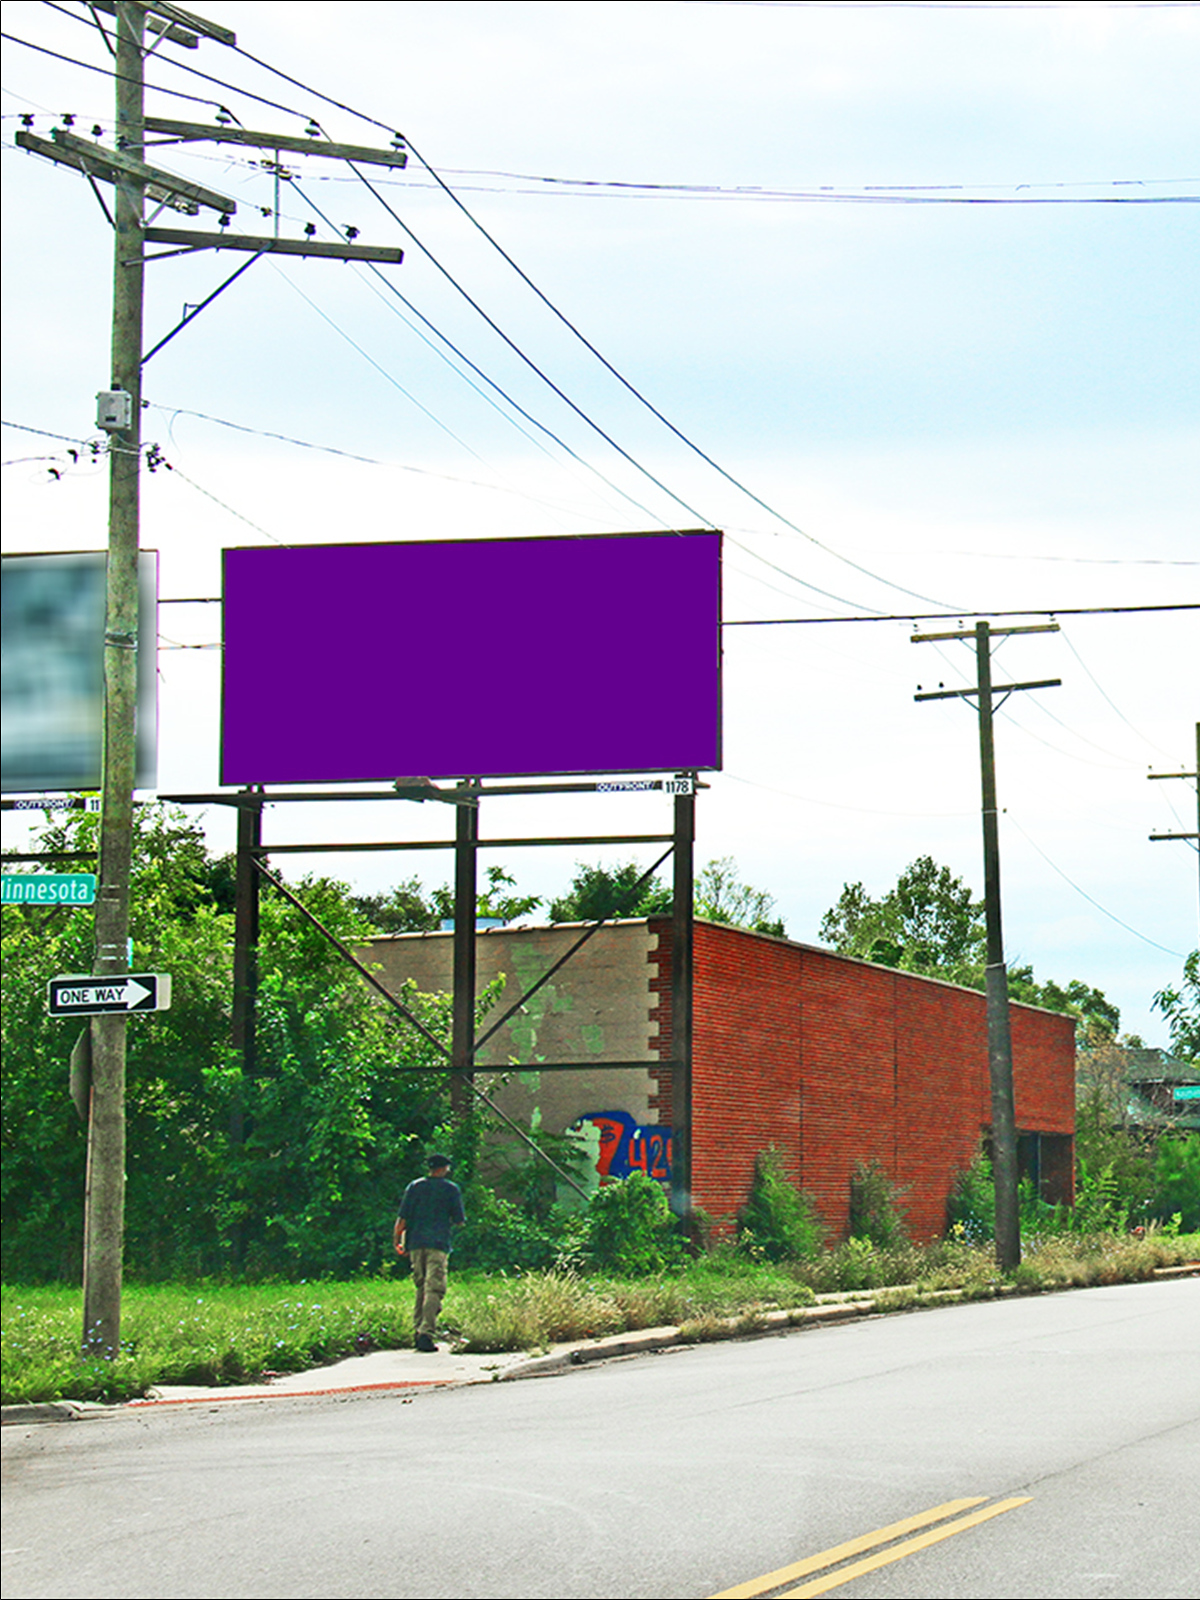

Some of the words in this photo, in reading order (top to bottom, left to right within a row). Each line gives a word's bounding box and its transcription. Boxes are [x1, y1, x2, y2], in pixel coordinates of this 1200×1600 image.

[666, 781, 689, 793] 1178
[60, 989, 90, 1004] ONE
[95, 987, 125, 1002] WAY
